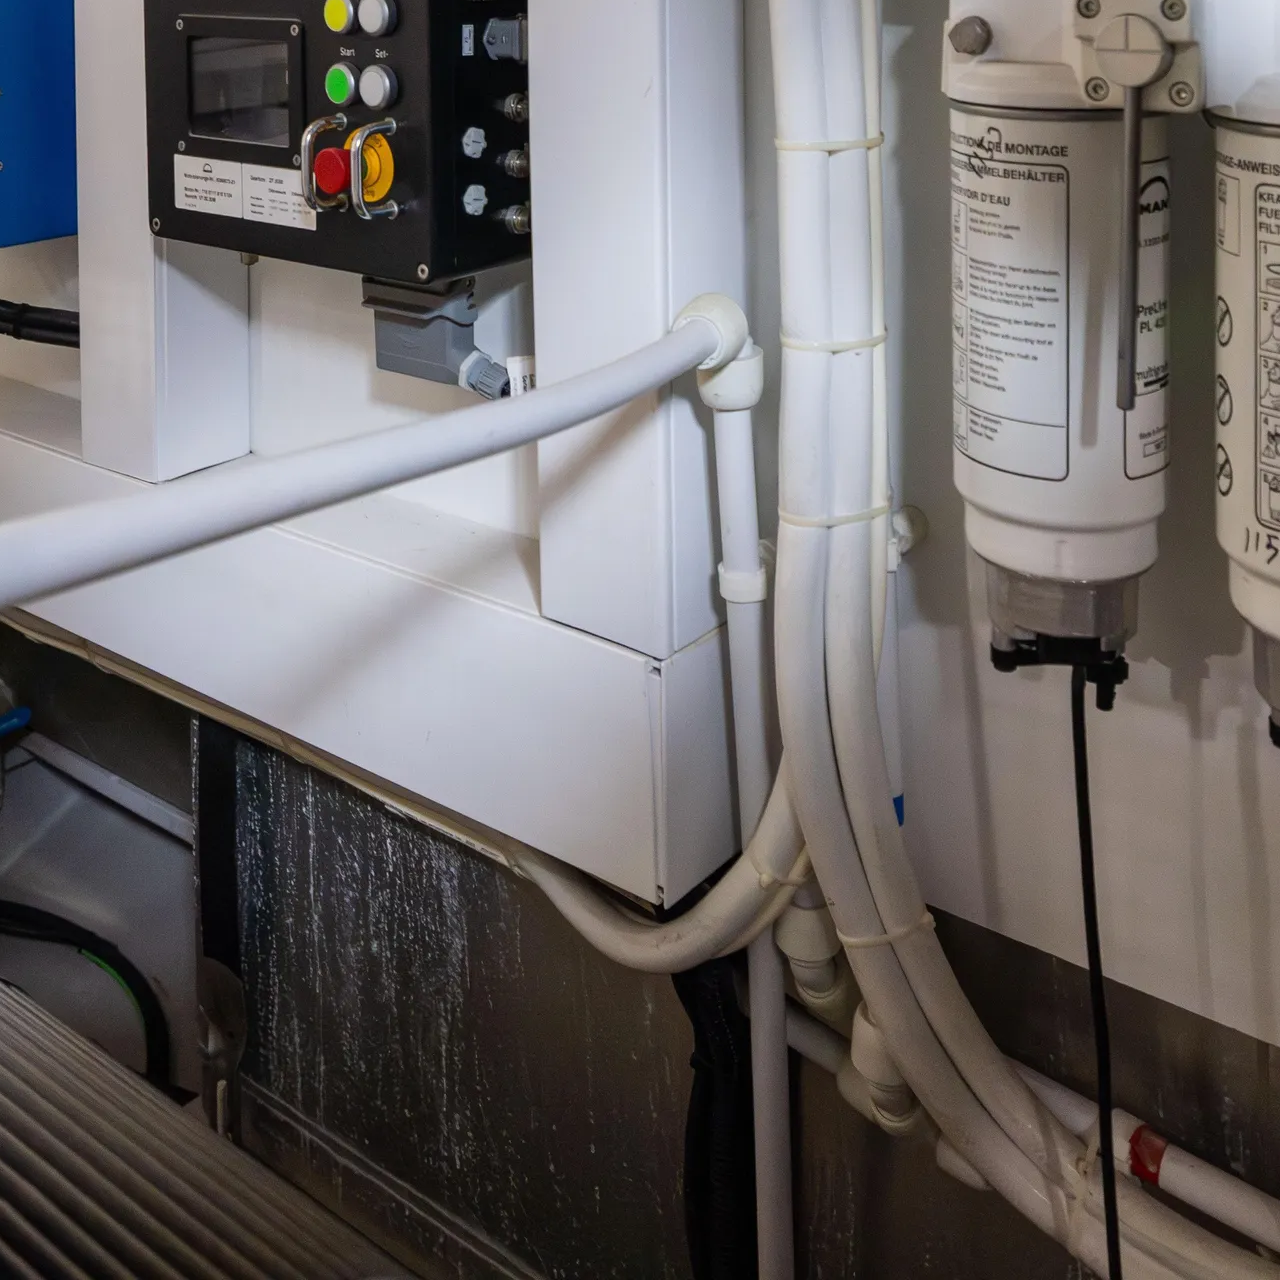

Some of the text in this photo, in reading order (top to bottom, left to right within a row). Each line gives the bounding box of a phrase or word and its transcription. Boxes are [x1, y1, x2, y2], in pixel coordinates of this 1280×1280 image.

[340, 47, 355, 56] Start
[1005, 143, 1069, 157] MONTAGE
[980, 192, 1010, 206] D'EAU
